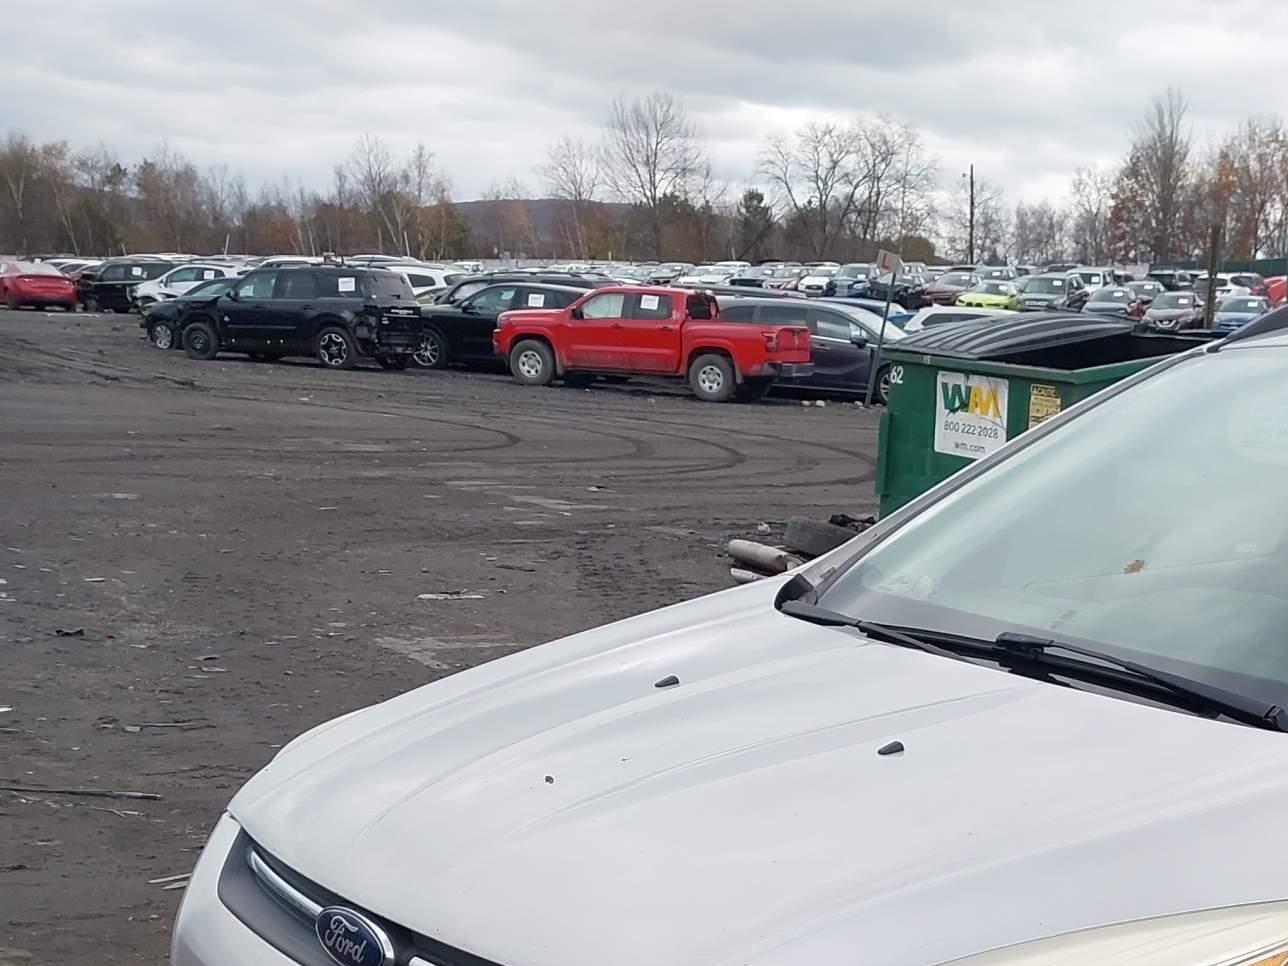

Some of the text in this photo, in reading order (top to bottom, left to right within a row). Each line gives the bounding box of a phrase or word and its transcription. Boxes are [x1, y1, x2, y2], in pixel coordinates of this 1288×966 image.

[890, 365, 904, 384] 62
[944, 420, 999, 439] 800 222 2028
[954, 441, 986, 454] wm.com
[324, 915, 367, 963] Ford
